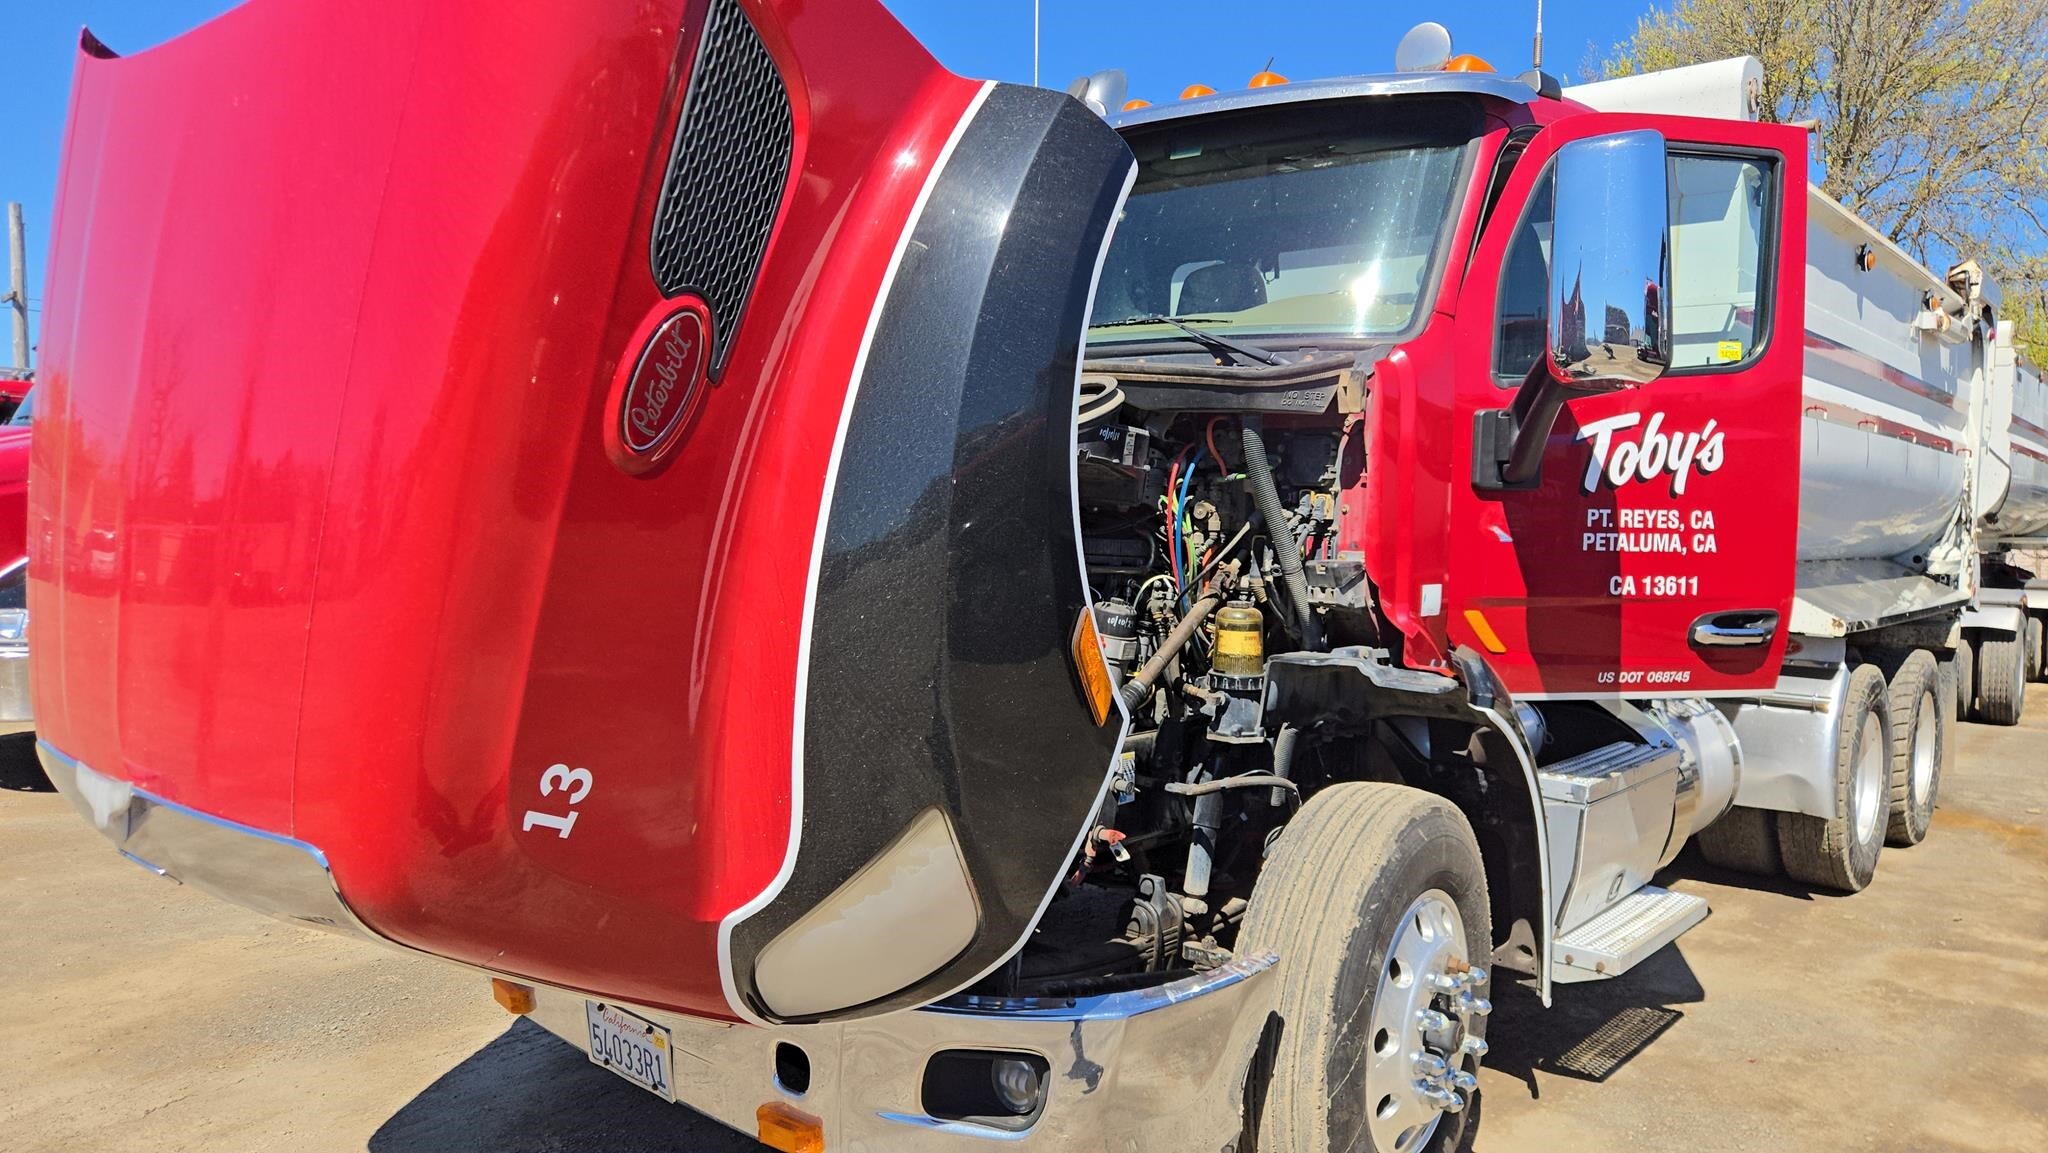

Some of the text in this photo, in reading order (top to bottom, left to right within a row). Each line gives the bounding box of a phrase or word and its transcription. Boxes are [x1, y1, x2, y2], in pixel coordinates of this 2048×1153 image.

[632, 321, 692, 438] Peterbilt
[1282, 391, 1326, 401] NO STEP
[1574, 411, 1725, 498] Toby's
[1587, 509, 1715, 532] PT. REYES, CA
[1582, 533, 1717, 556] PETALUMA, CA
[1609, 575, 1699, 596] CA 13611
[1597, 671, 1692, 683] US DOT 068745
[522, 763, 593, 839] 13
[603, 1007, 647, 1038] California
[592, 1023, 666, 1089] 54033R1
